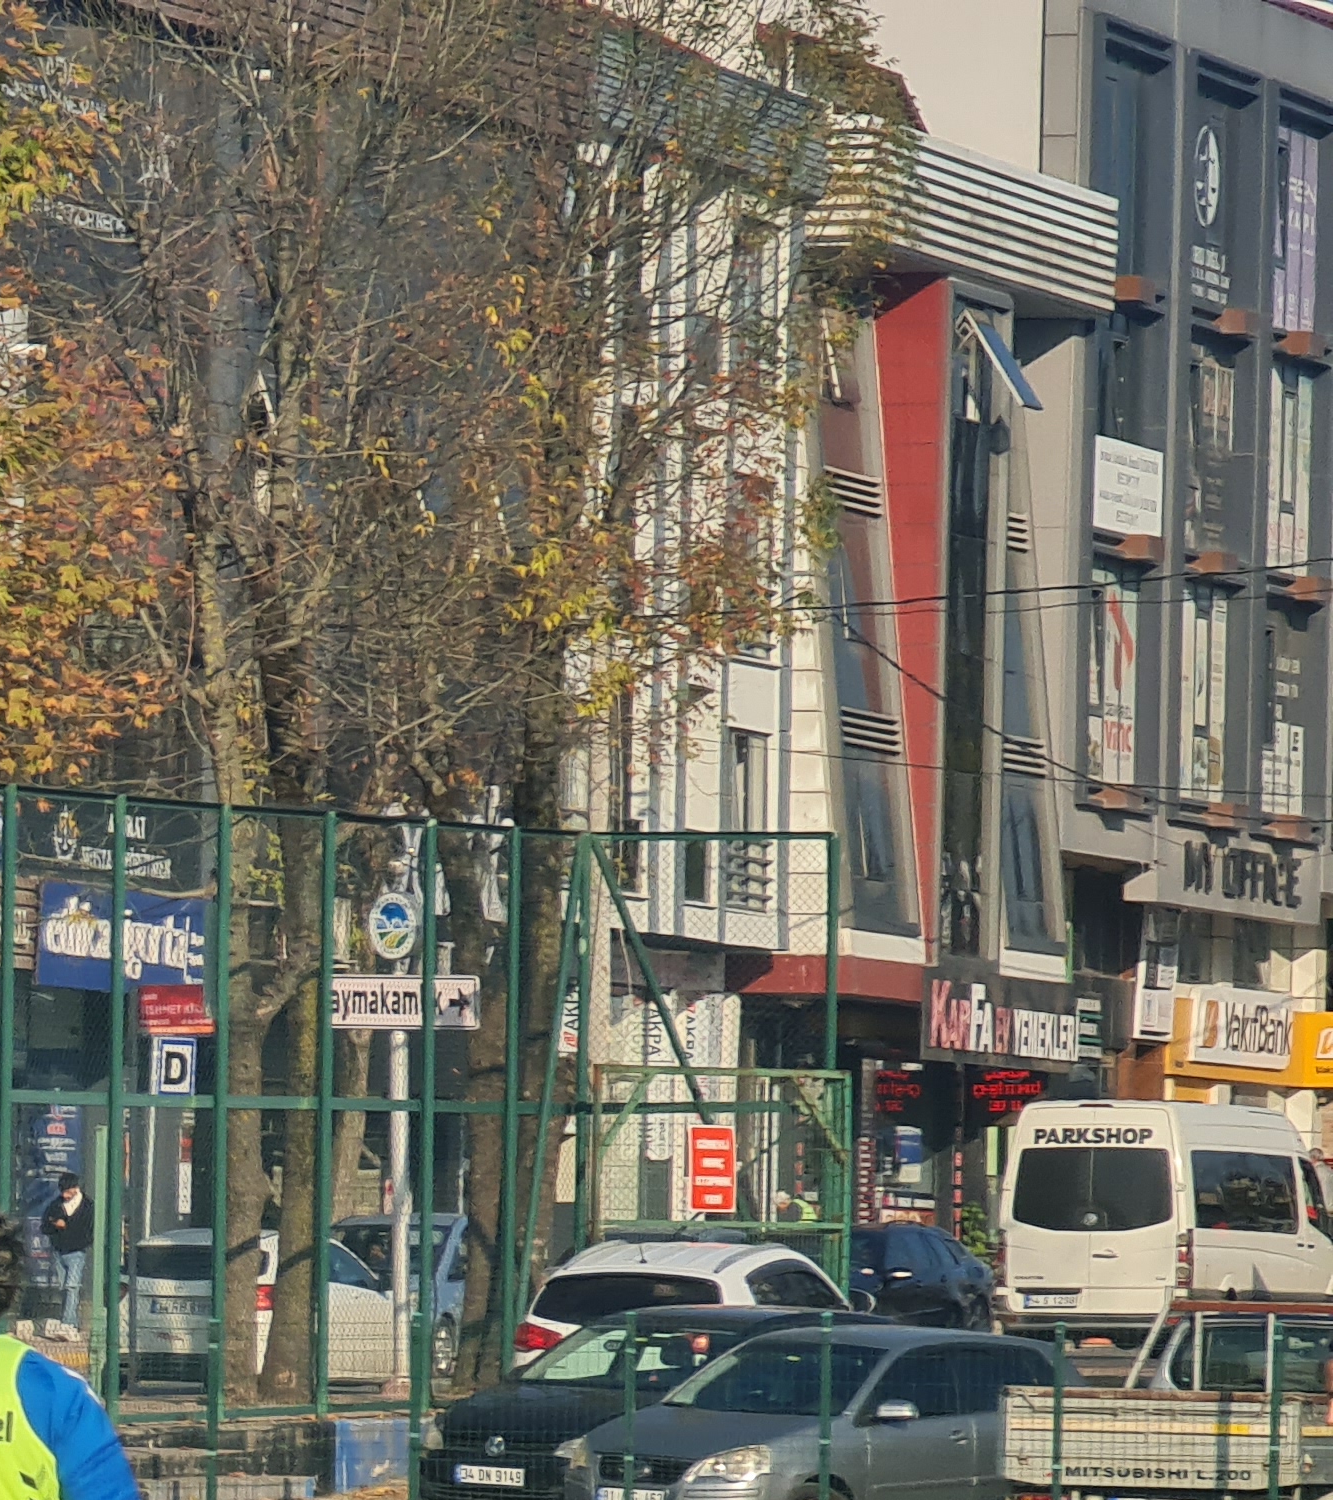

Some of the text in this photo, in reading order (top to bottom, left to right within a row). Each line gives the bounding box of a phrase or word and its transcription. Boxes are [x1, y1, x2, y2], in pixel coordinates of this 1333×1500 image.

[332, 983, 444, 1021] aymakamk
[164, 1051, 188, 1086] D
[1033, 1127, 1154, 1145] PARKSHOP
[460, 1467, 475, 1480] 34
[495, 1470, 522, 1484] 9149
[1064, 1465, 1189, 1480] MITSUBISHI
